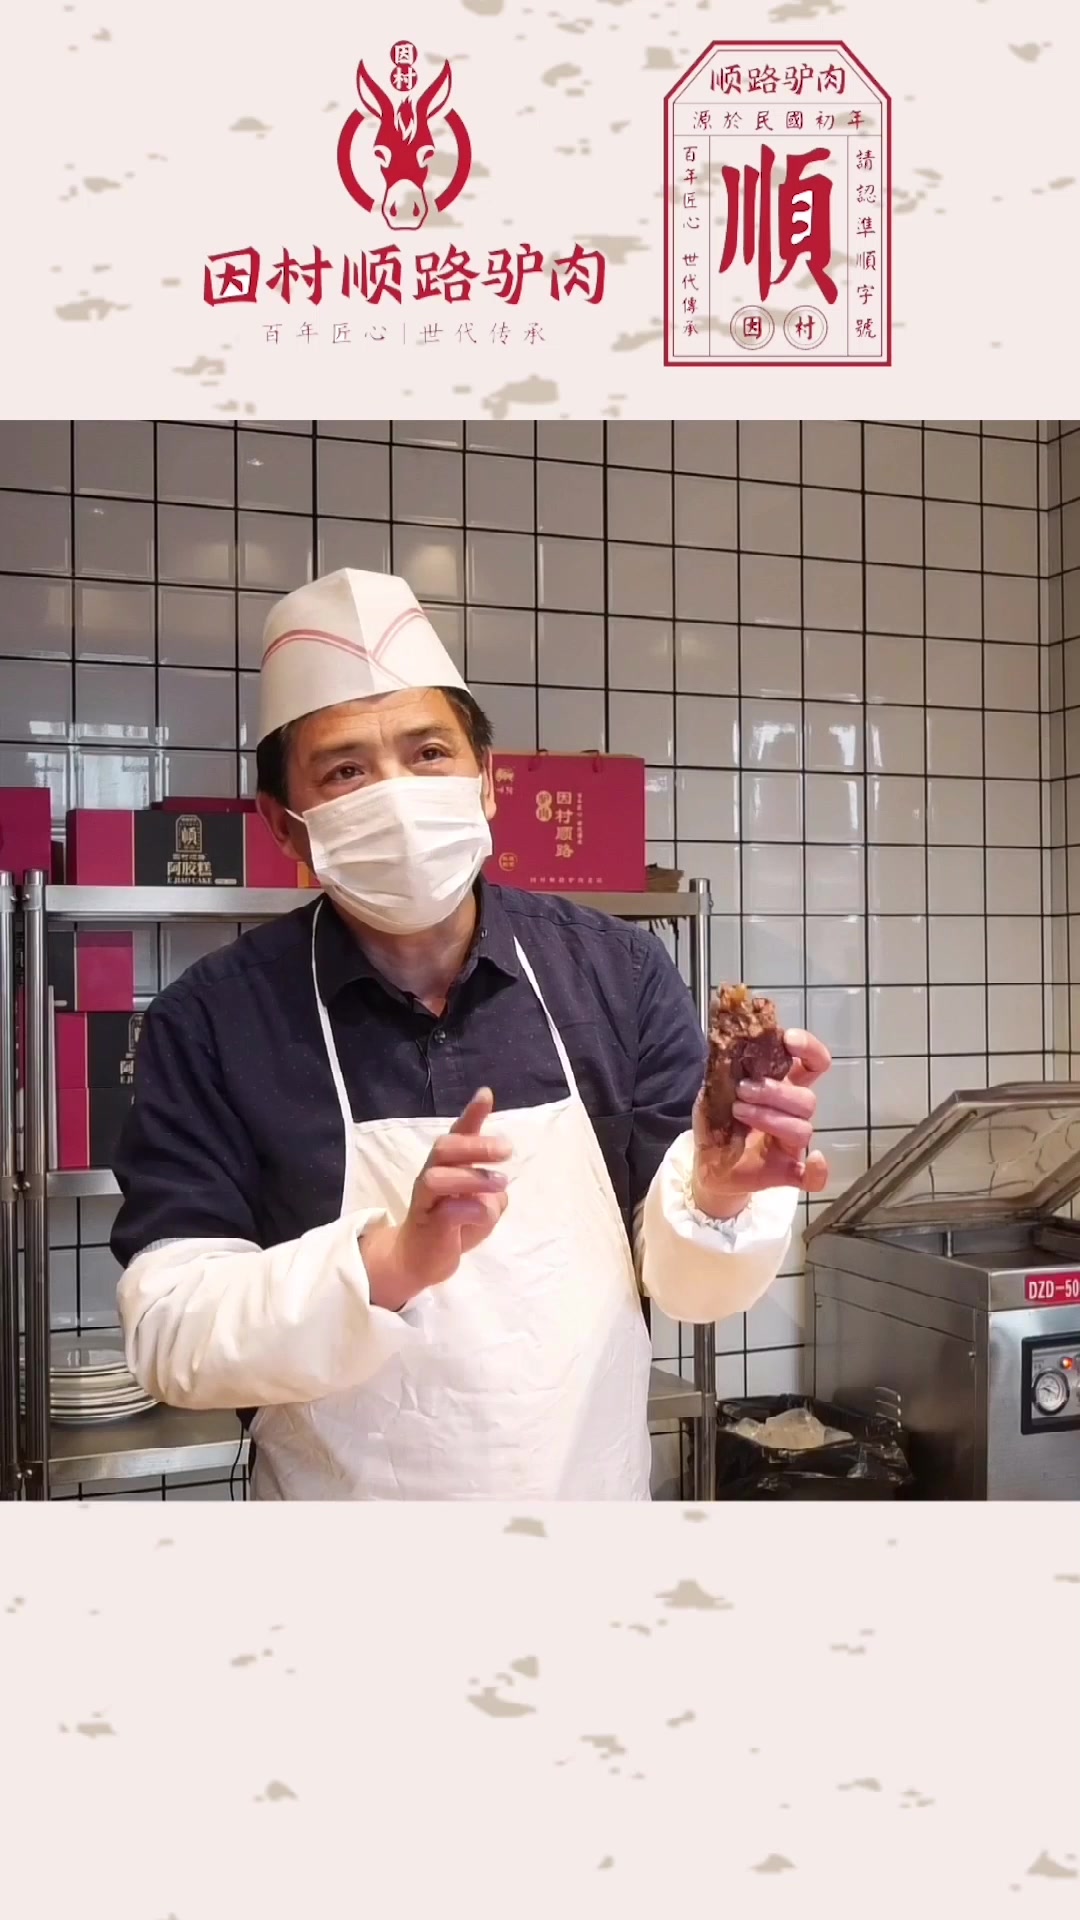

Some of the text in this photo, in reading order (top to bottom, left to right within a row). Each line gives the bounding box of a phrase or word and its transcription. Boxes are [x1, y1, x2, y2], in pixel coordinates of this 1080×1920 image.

[555, 791, 574, 858] 因村顺路
[167, 861, 212, 876] 阿胶糕
[192, 877, 213, 885] CAKE
[1028, 1278, 1080, 1299] DZD-50
